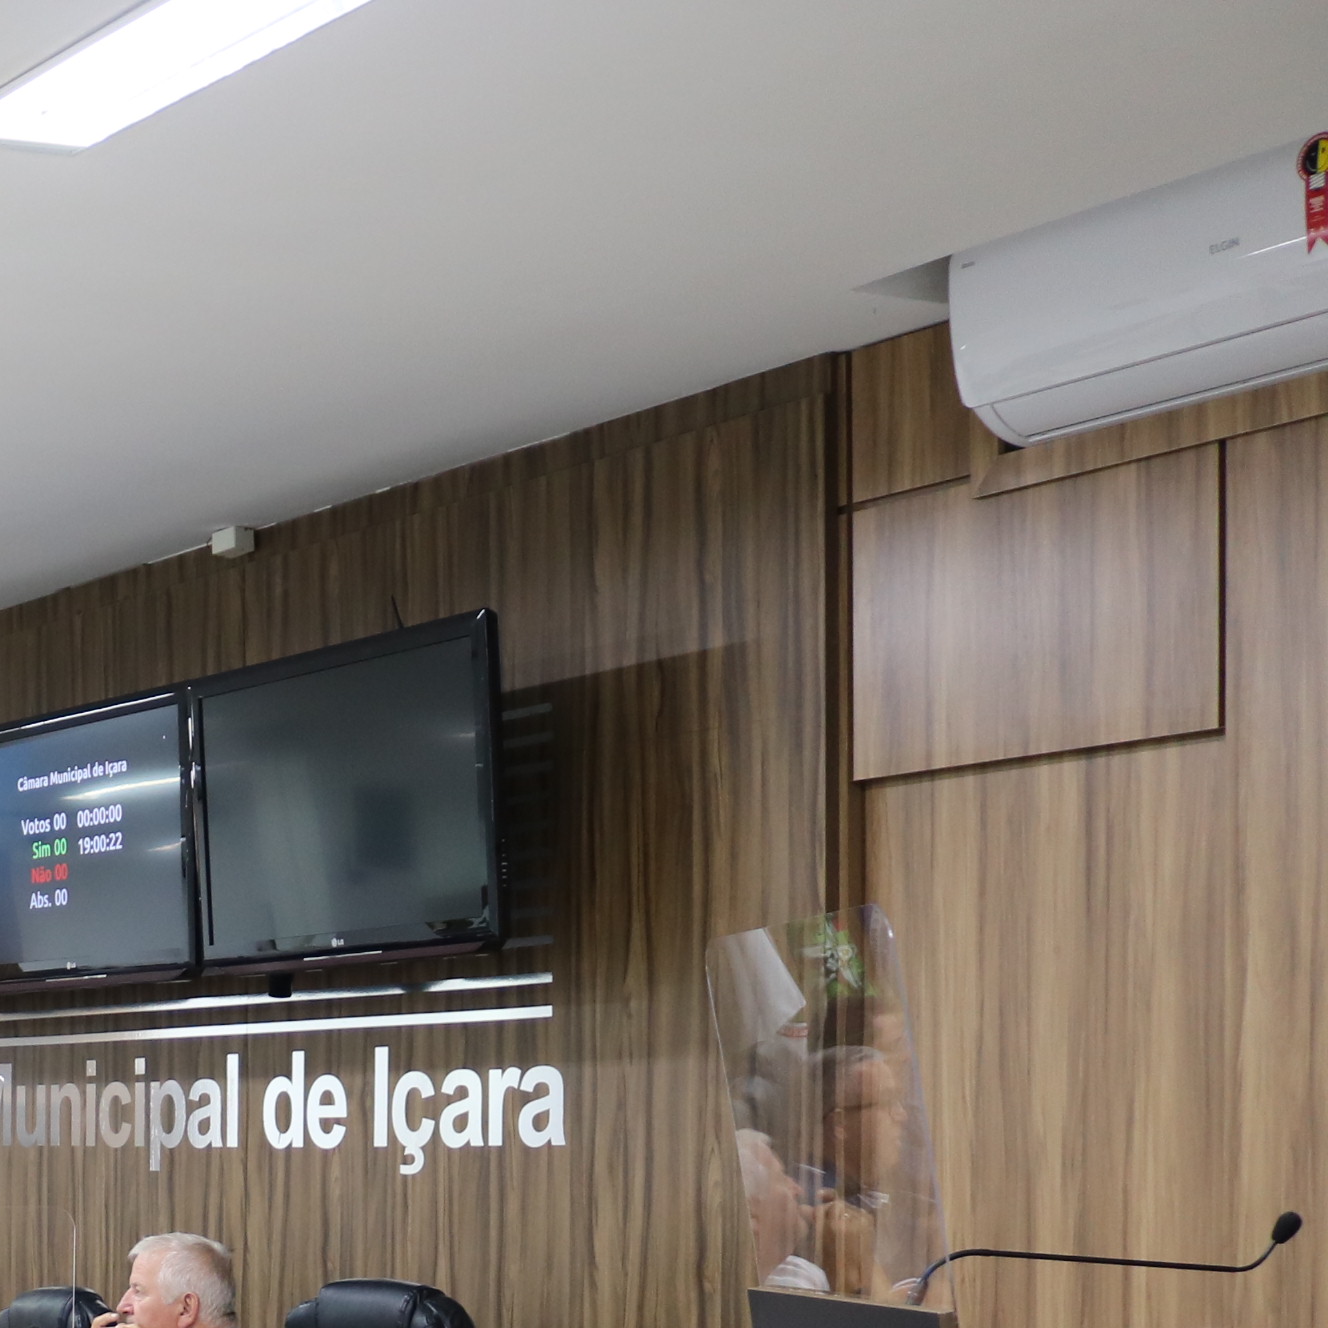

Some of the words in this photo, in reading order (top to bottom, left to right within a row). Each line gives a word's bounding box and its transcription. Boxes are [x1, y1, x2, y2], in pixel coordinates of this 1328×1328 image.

[17, 774, 48, 792] Câmara
[50, 763, 92, 787] Municipal
[93, 761, 104, 777] de
[105, 759, 127, 778] Içara
[21, 817, 51, 836] Votos
[53, 812, 67, 831] 00
[77, 804, 123, 828] 00:00:00
[32, 841, 51, 860] Sim
[54, 837, 67, 856] 00
[78, 831, 123, 855] 19:00:22
[31, 866, 52, 884] Não
[54, 863, 68, 881] 00
[29, 891, 52, 910] Abs.
[54, 888, 68, 906] 00
[262, 1049, 347, 1149] de
[374, 1046, 566, 1176] Içara
